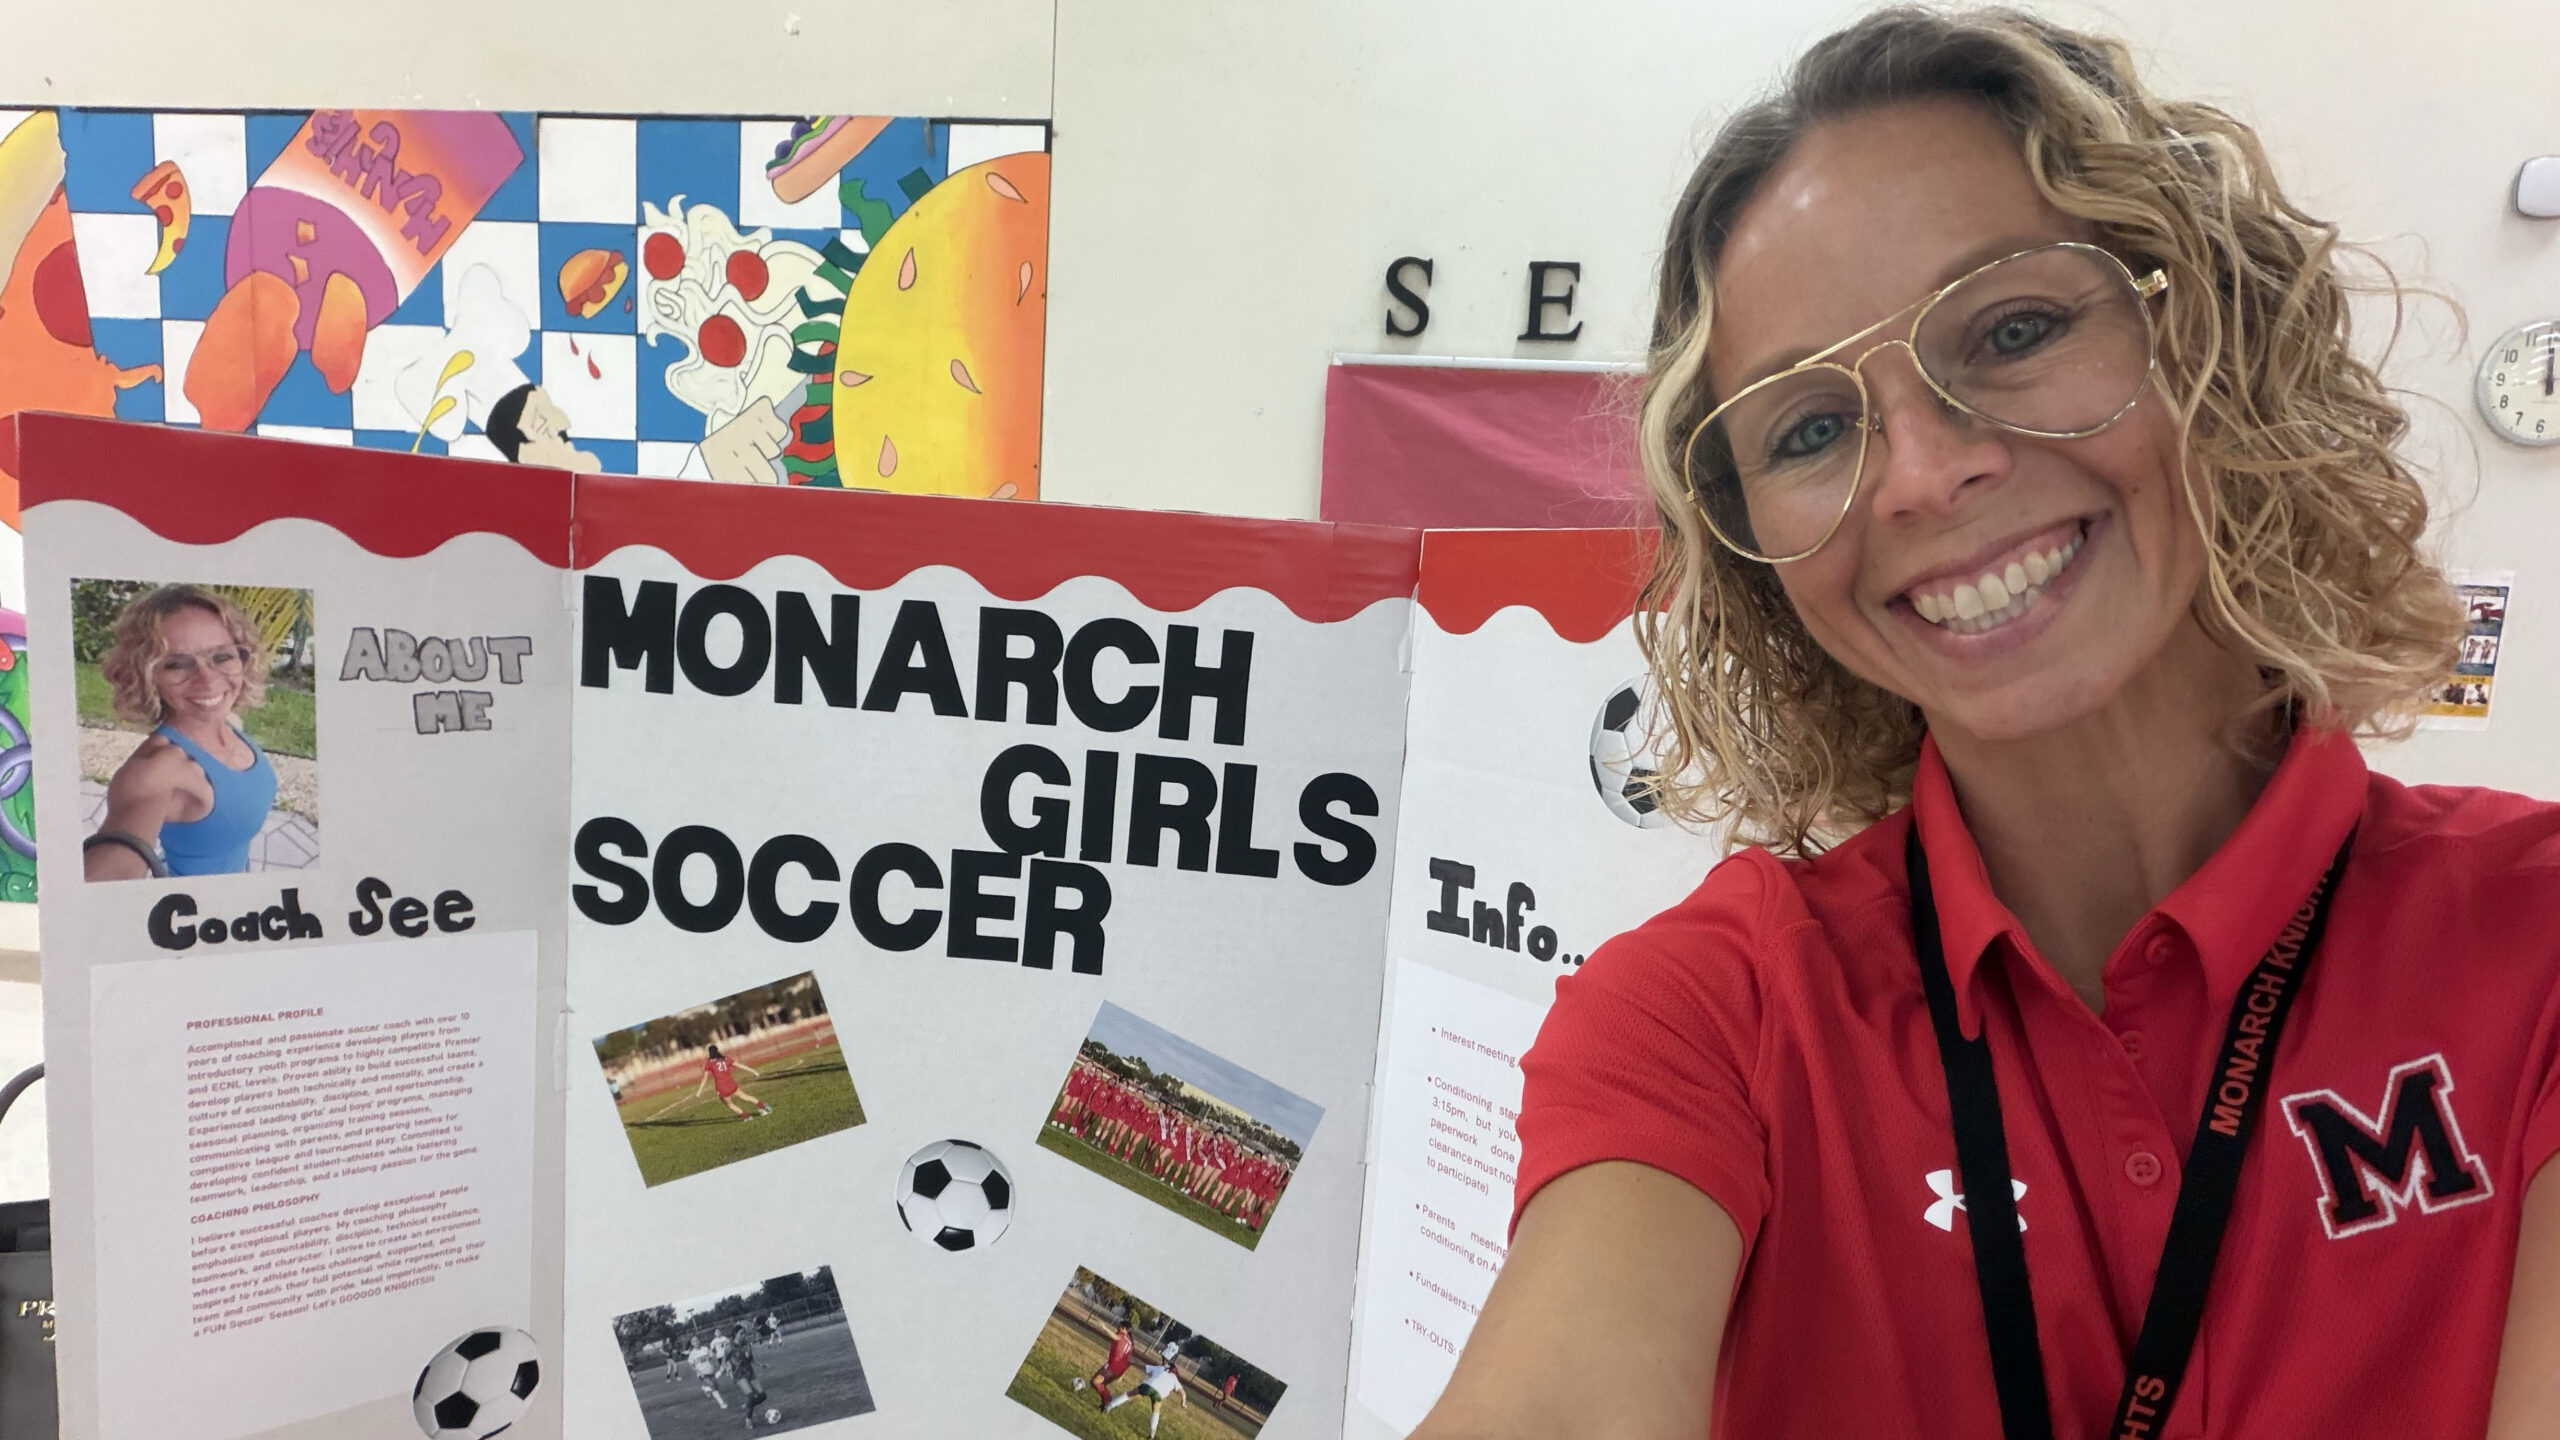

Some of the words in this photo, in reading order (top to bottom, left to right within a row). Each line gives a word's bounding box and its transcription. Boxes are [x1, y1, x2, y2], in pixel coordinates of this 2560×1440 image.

[2504, 349, 2518, 363] 10
[2525, 333, 2536, 346] 11
[2496, 372, 2505, 386] 9
[2499, 394, 2509, 408] 8
[2515, 411, 2524, 426] 7
[2535, 419, 2545, 433] 6
[339, 627, 533, 685] ABOUT
[581, 575, 1254, 746] MONARCH
[413, 691, 494, 734] ME
[981, 743, 1380, 886] GIRLS
[148, 888, 323, 950] Coach
[349, 877, 476, 938] See
[572, 816, 1113, 976] SOCCER
[186, 1014, 275, 1029] PROFESSIONAL
[278, 1009, 324, 1019] PROFILE
[716, 1062, 727, 1072] 21
[1441, 1028, 1474, 1050] Interest
[1477, 1044, 1515, 1068] meeting
[2209, 971, 2287, 1137] MONARCH
[1435, 1076, 1492, 1112] Conditioning
[1433, 1097, 1468, 1122] 3:15pm,
[1476, 1116, 1491, 1132] but
[1498, 1128, 1516, 1142] you
[1429, 1137, 1472, 1165] clearance
[1474, 1159, 1497, 1177] must
[1431, 1118, 1477, 1146] paperwork
[1491, 1145, 1514, 1163] done
[2281, 1052, 2494, 1240] M
[1427, 1157, 1435, 1168] to
[1438, 1162, 1489, 1196] participate)
[190, 1207, 249, 1224] COACHING
[252, 1194, 320, 1212] PHILOSOPHY
[1421, 1225, 1474, 1264] conditioning
[1477, 1258, 1488, 1269] on
[1422, 1204, 1455, 1231] Parents
[1471, 1232, 1508, 1259] meeting
[1416, 1272, 1469, 1312] Fundraisers:
[1411, 1320, 1456, 1355] TRY-OUTS:
